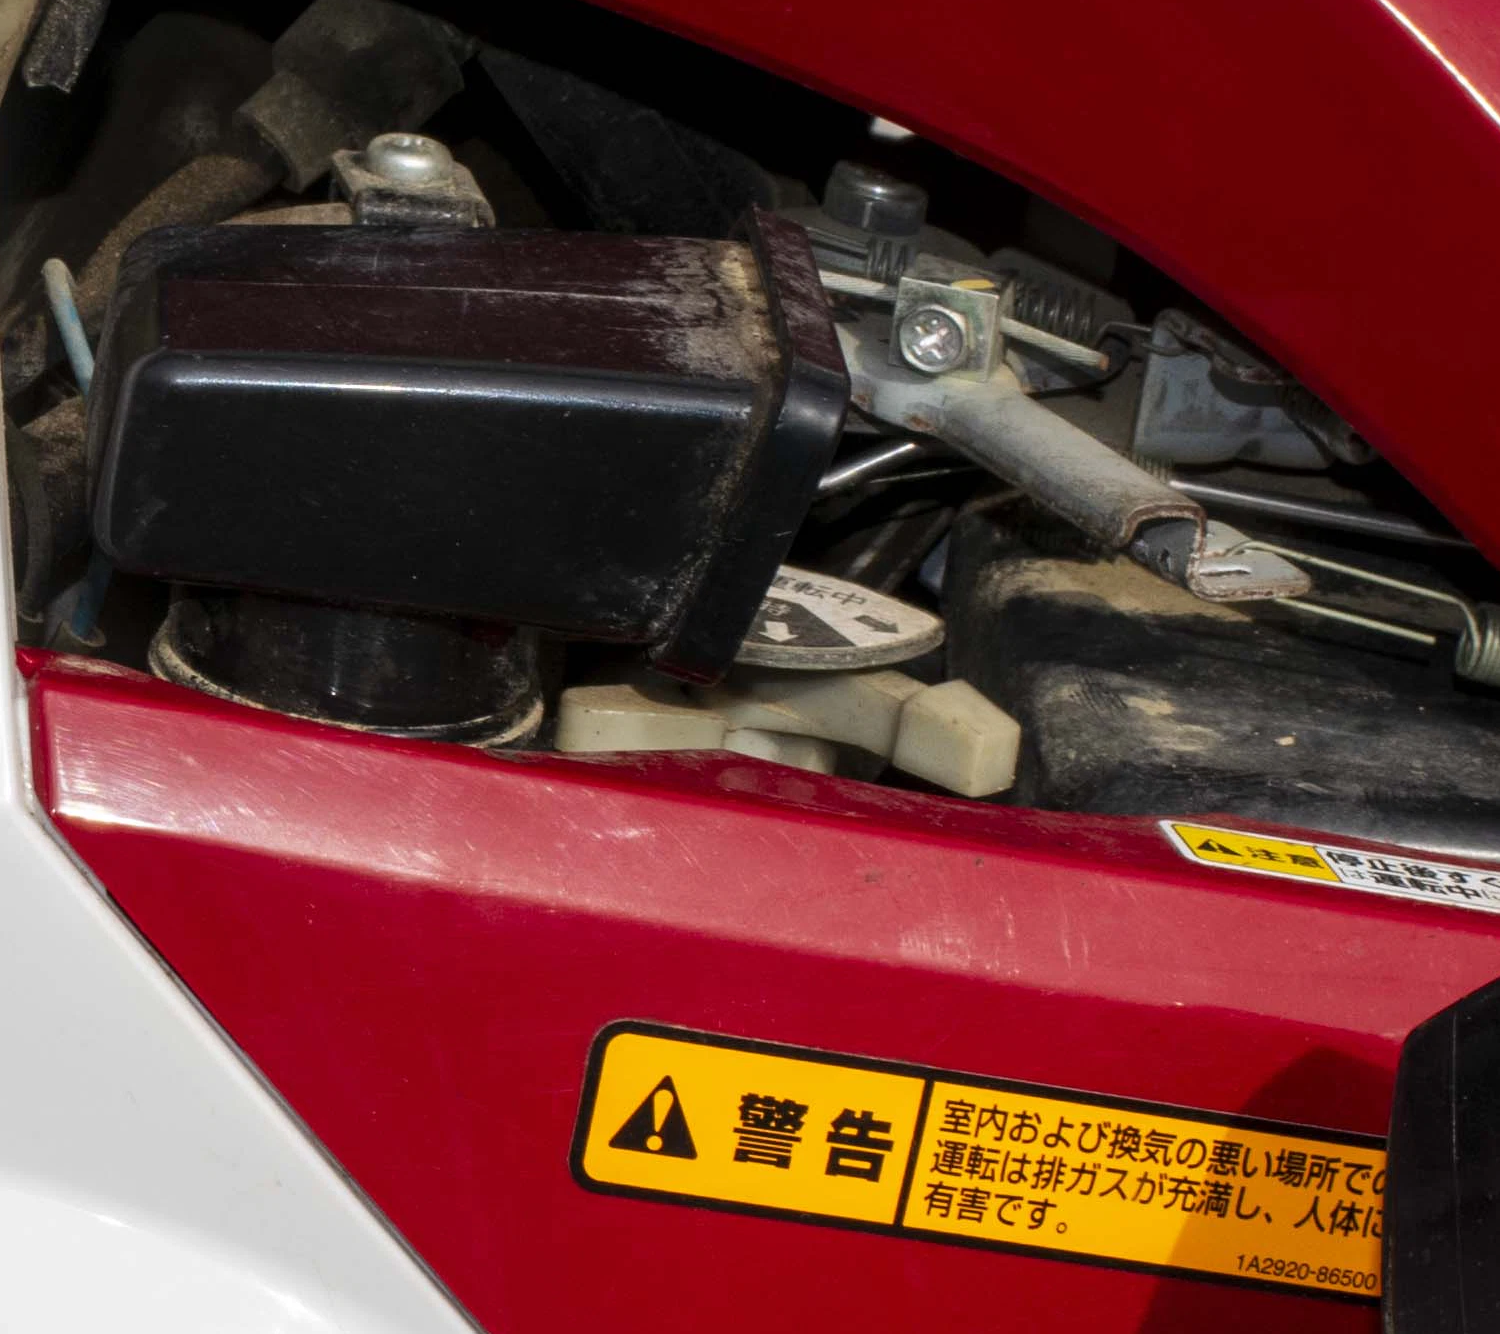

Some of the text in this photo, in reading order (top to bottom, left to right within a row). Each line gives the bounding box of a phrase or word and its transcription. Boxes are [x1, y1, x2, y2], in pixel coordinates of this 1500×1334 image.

[1246, 845, 1324, 869] 注意
[733, 1093, 895, 1182] 警告
[924, 1180, 1068, 1235] 有害です。
[1236, 1254, 1377, 1291] 1A2920-86500
